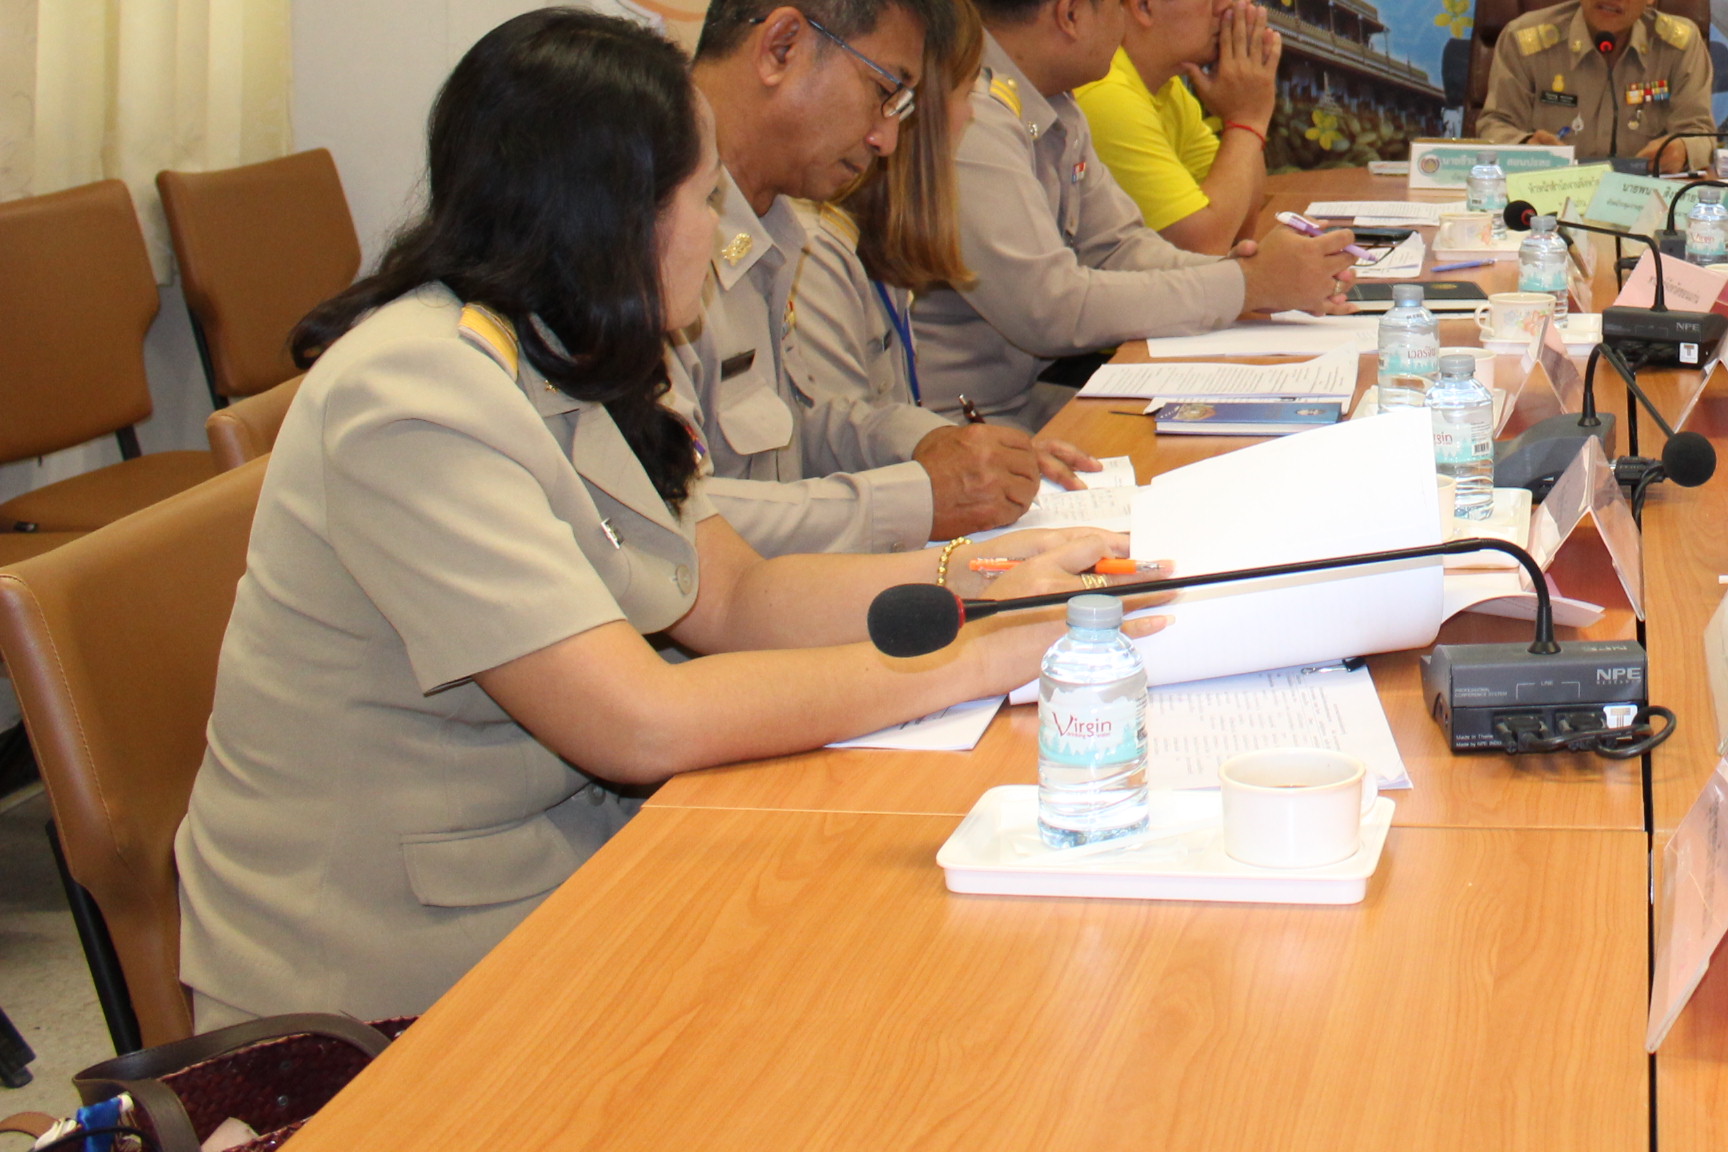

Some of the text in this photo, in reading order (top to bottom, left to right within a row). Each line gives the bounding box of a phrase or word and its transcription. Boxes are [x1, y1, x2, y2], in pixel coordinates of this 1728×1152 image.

[1676, 322, 1700, 332] NPE
[1596, 667, 1641, 680] NPE
[1052, 711, 1112, 738] Virgin
